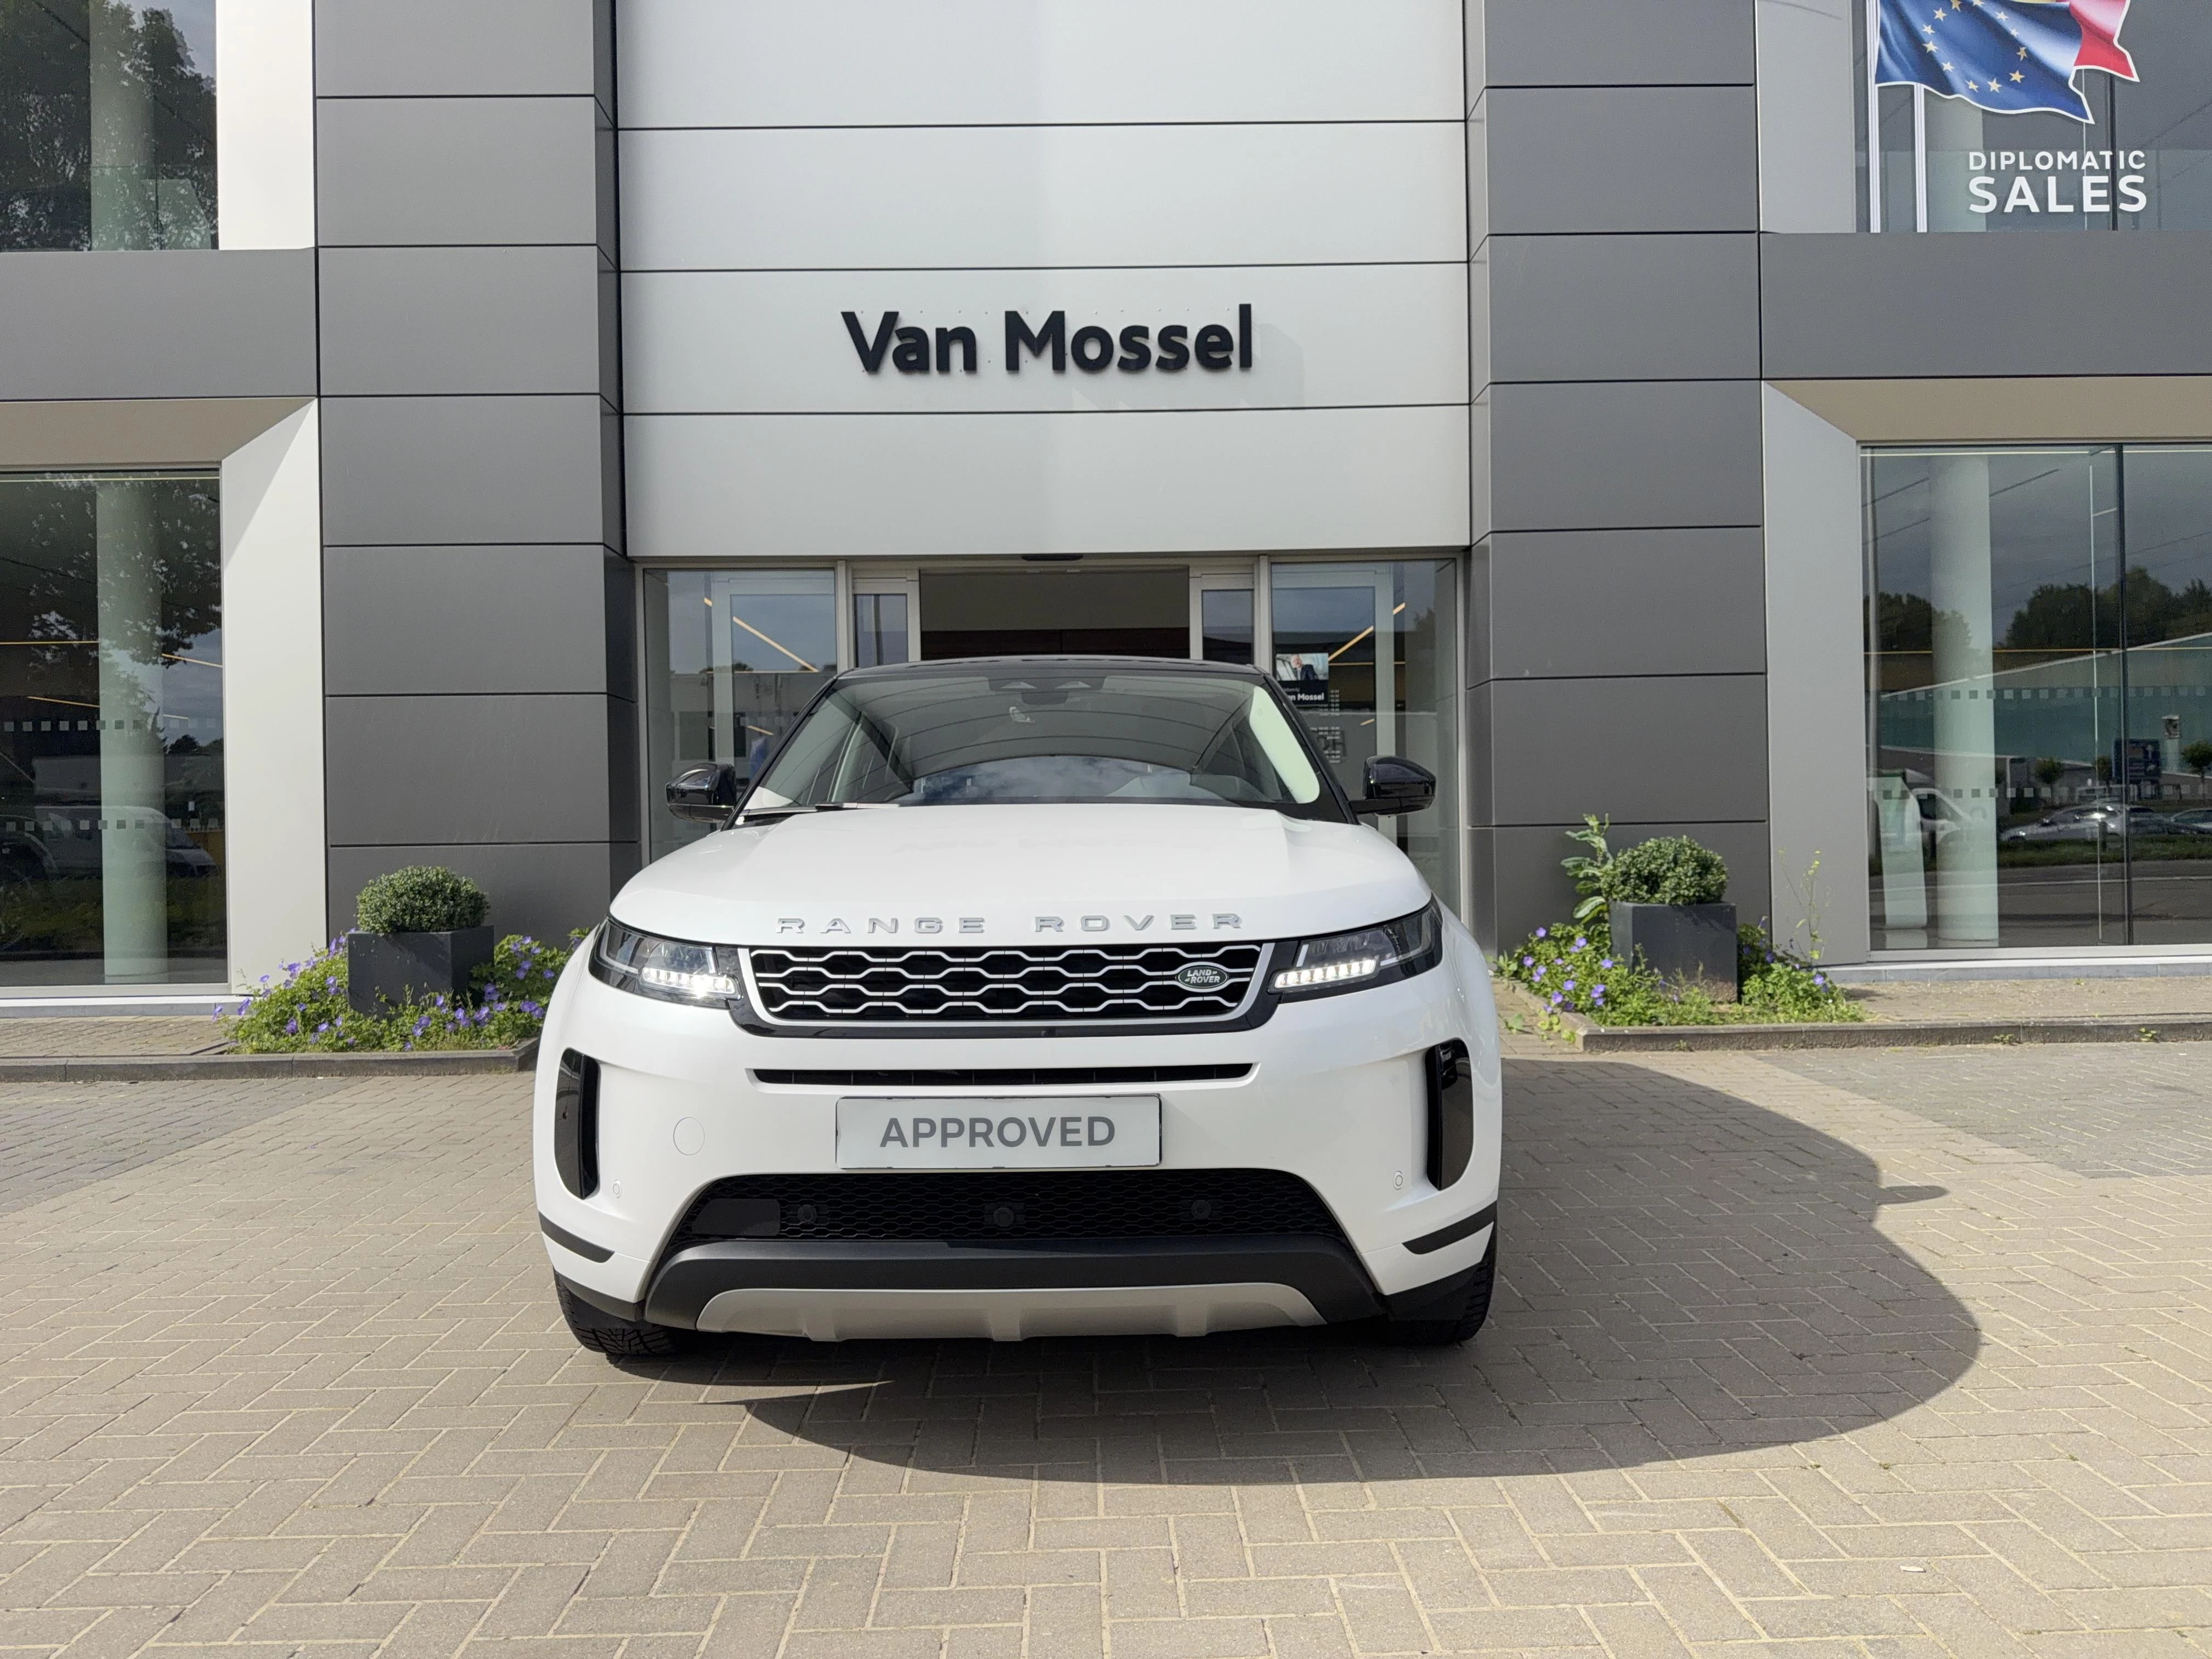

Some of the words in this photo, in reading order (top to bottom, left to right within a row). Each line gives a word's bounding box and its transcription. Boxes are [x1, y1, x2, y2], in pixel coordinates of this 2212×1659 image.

[1968, 150, 2146, 171] DIPLOMATIC
[1968, 175, 2147, 213] SALES
[840, 311, 977, 373] Van
[1005, 303, 1252, 371] Mossel
[1297, 692, 1325, 701] Mossel
[776, 917, 985, 934] RANGE
[1035, 913, 1243, 932] ROVER
[1190, 975, 1220, 984] ROVER
[879, 1116, 1115, 1148] APPROVED
